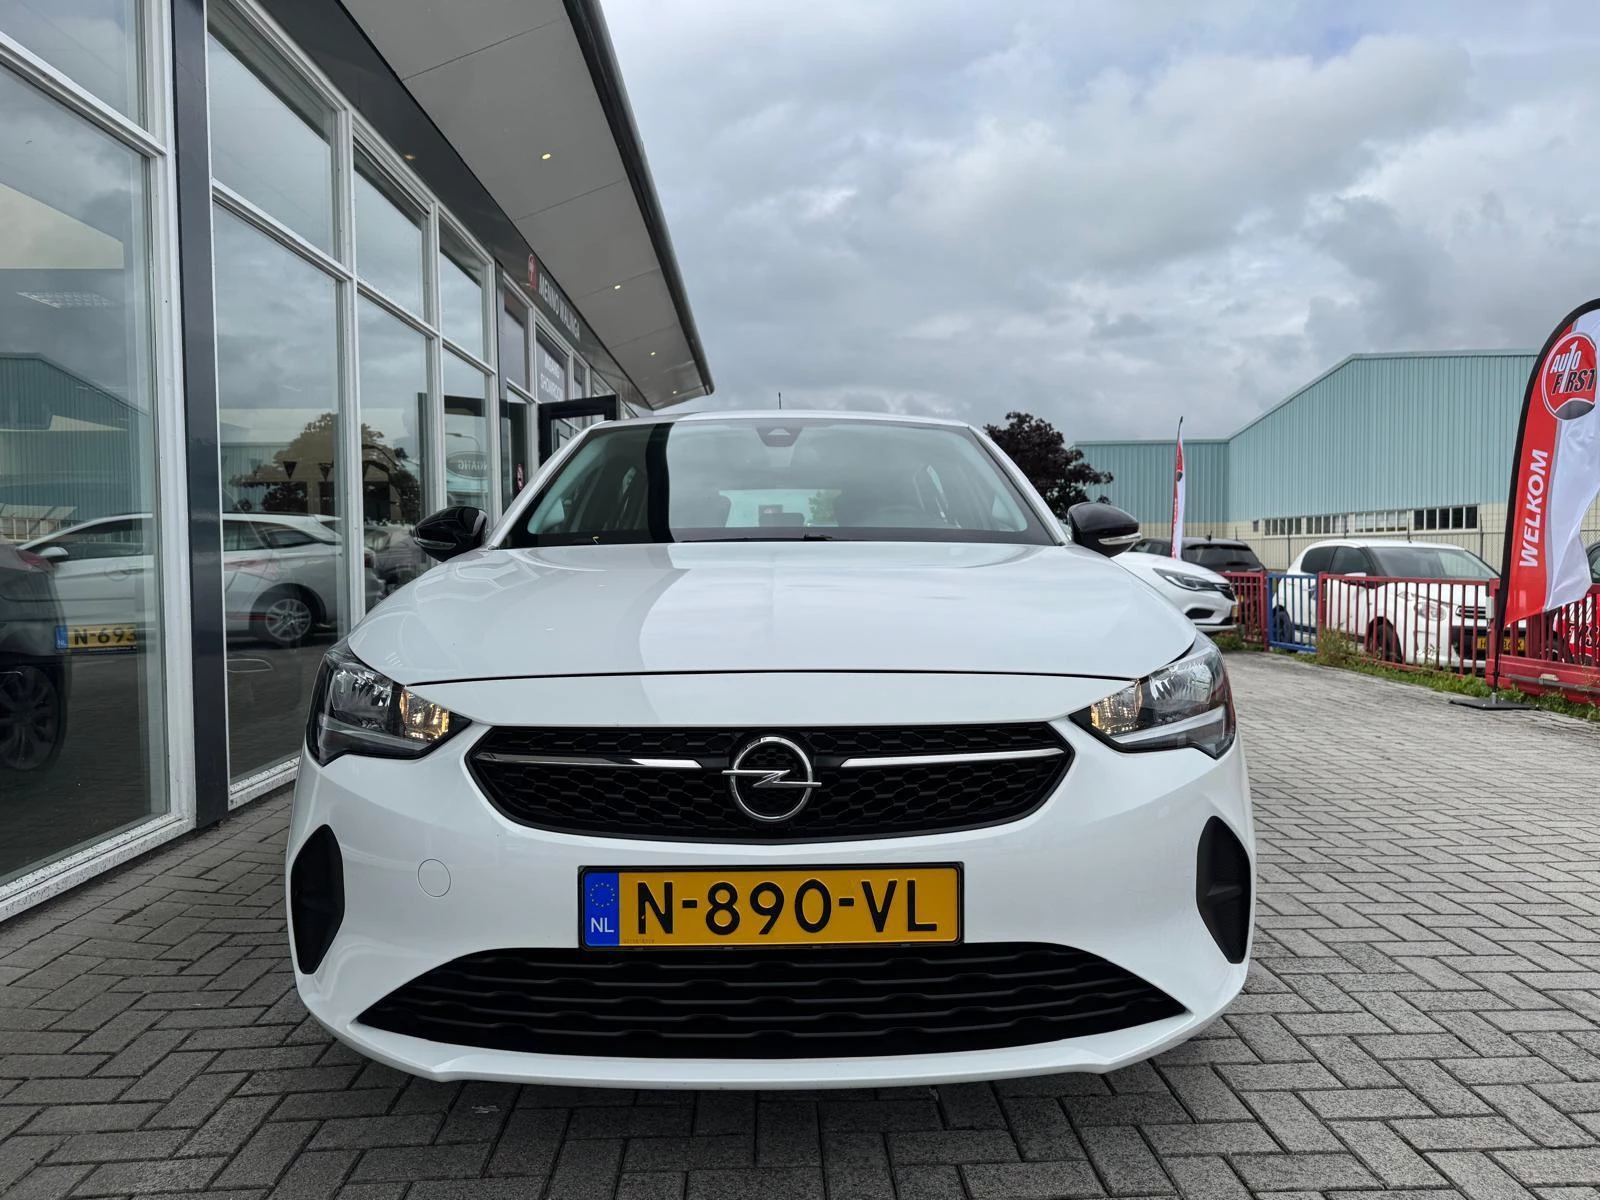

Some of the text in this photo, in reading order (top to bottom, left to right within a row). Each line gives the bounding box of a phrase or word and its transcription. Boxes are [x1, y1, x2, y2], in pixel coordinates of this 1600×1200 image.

[1551, 368, 1596, 395] FIRST
[1519, 449, 1548, 567] WELKOM
[591, 878, 938, 936] NL N-890-VL
